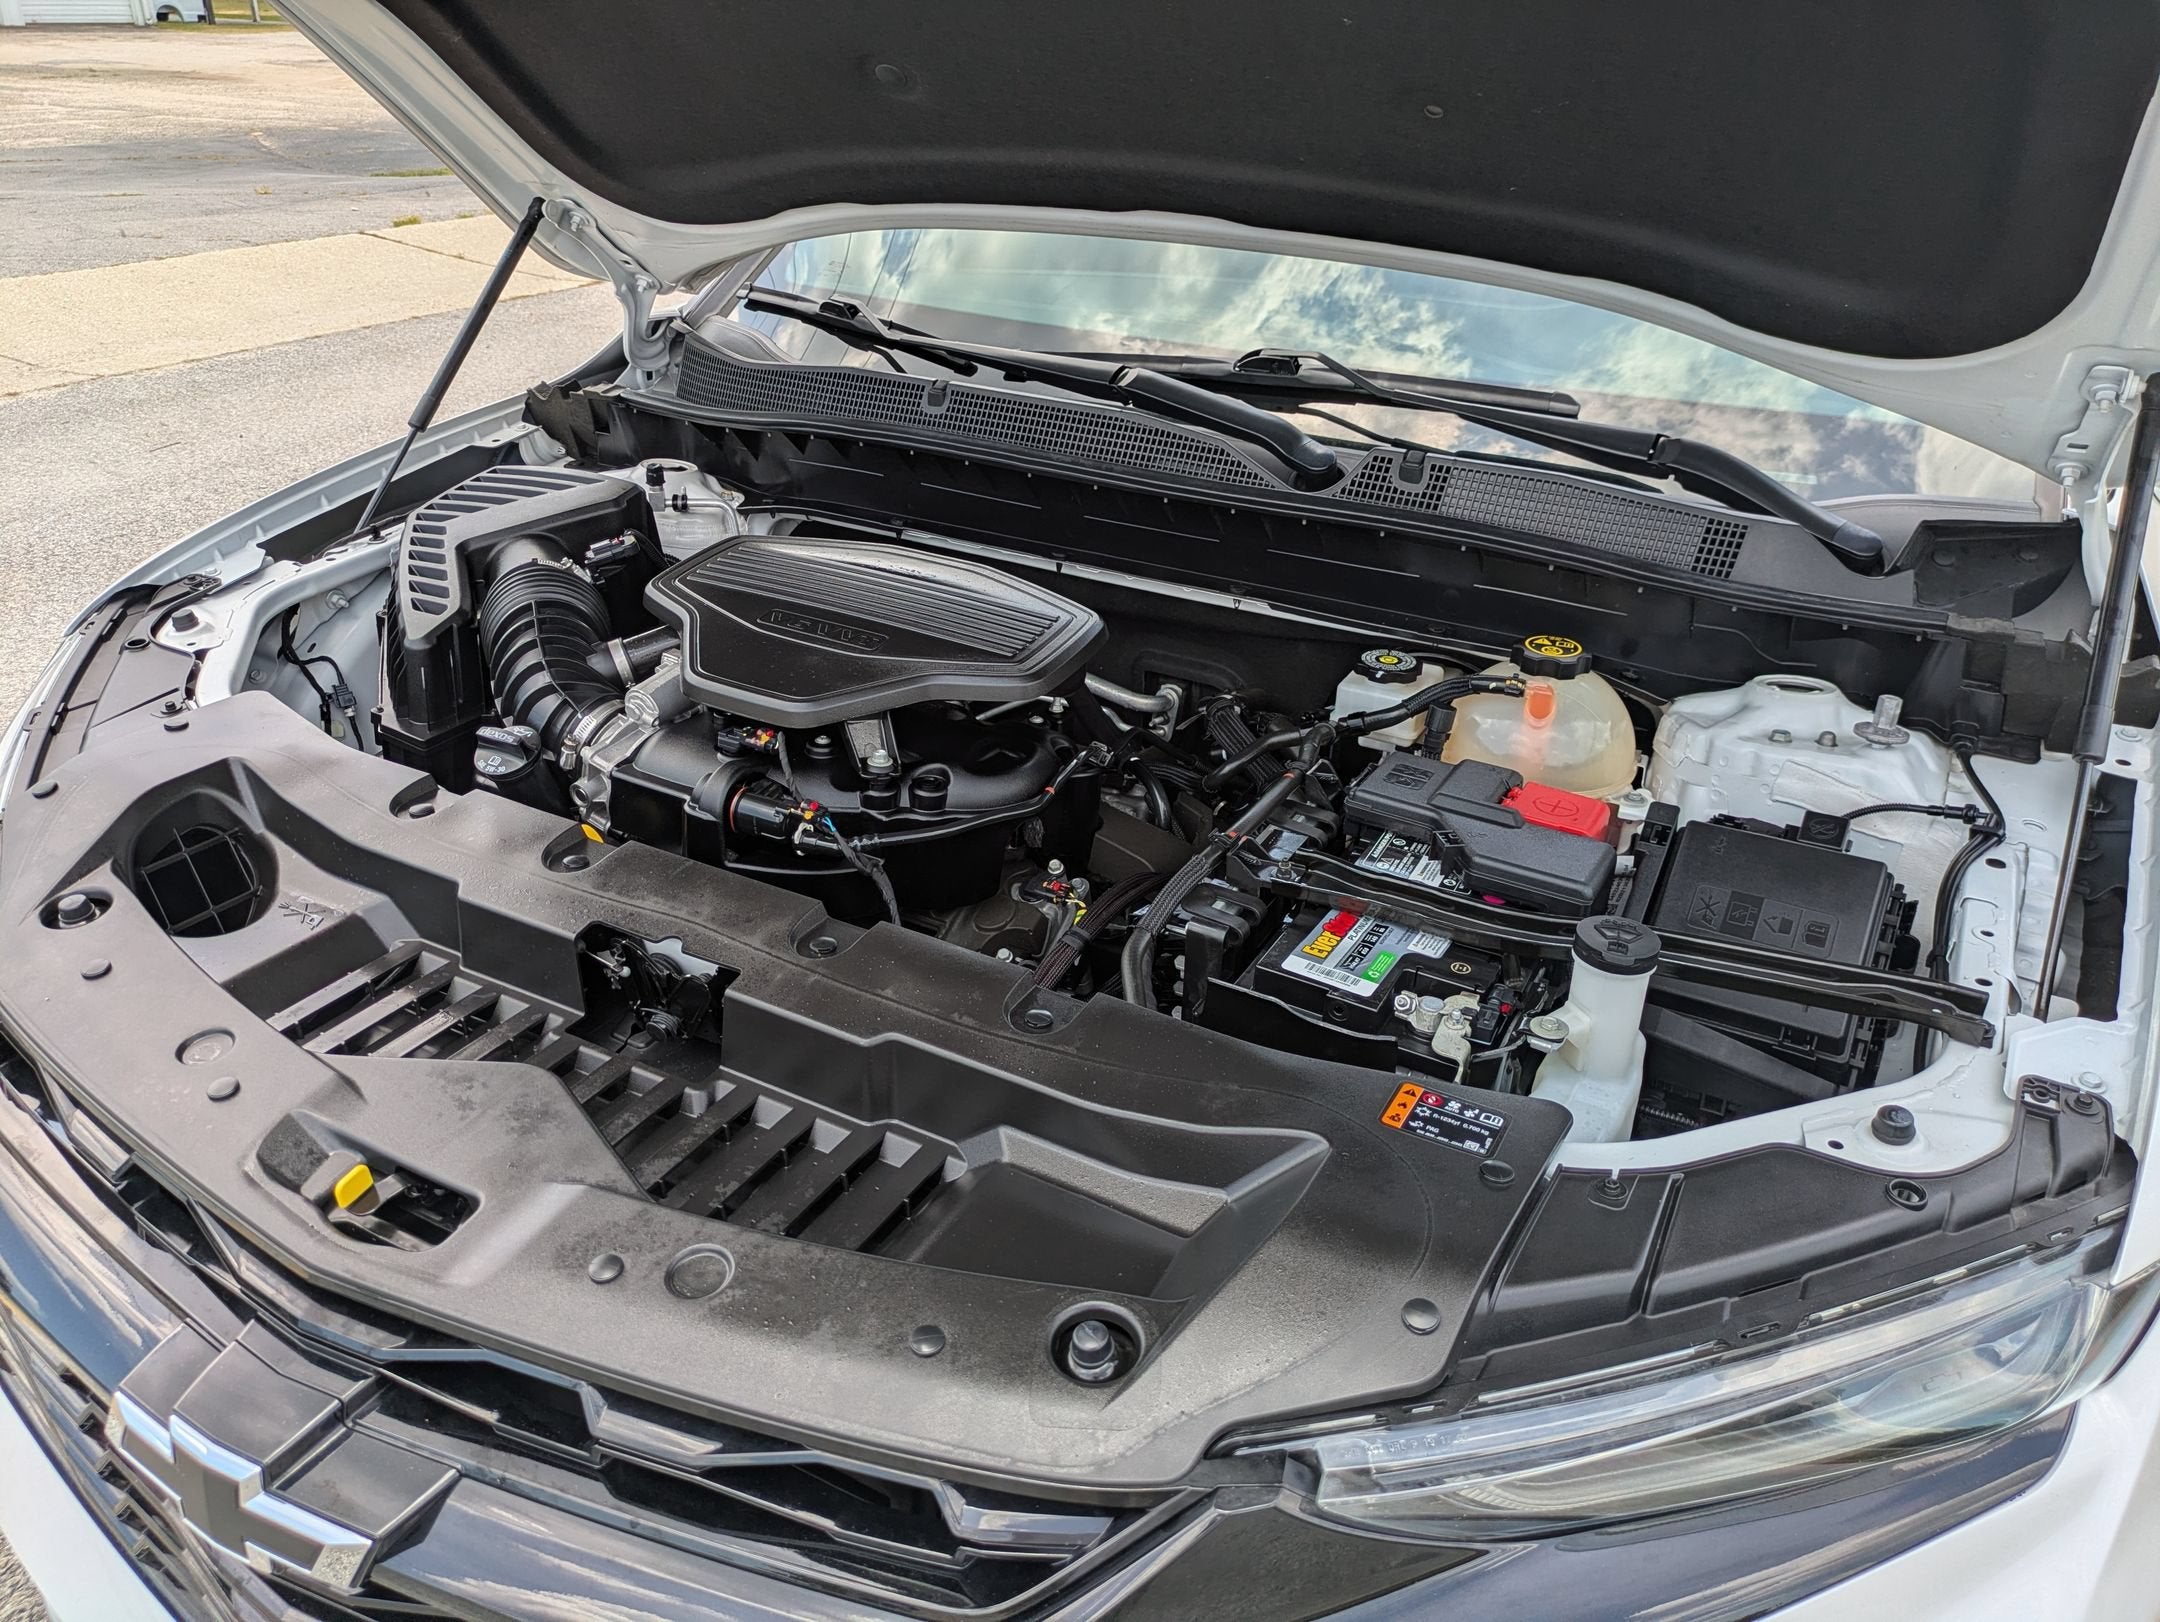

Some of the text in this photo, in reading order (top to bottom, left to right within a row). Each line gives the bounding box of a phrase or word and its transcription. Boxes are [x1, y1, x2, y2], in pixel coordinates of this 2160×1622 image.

[479, 727, 515, 743] dexos
[485, 765, 506, 773] 5W-30
[1347, 916, 1372, 941] PLATINUM
[1443, 1105, 1460, 1114] AUTO
[1425, 1125, 1440, 1134] PAG
[1432, 1113, 1490, 1136] R-1234yf 0.700 kg
